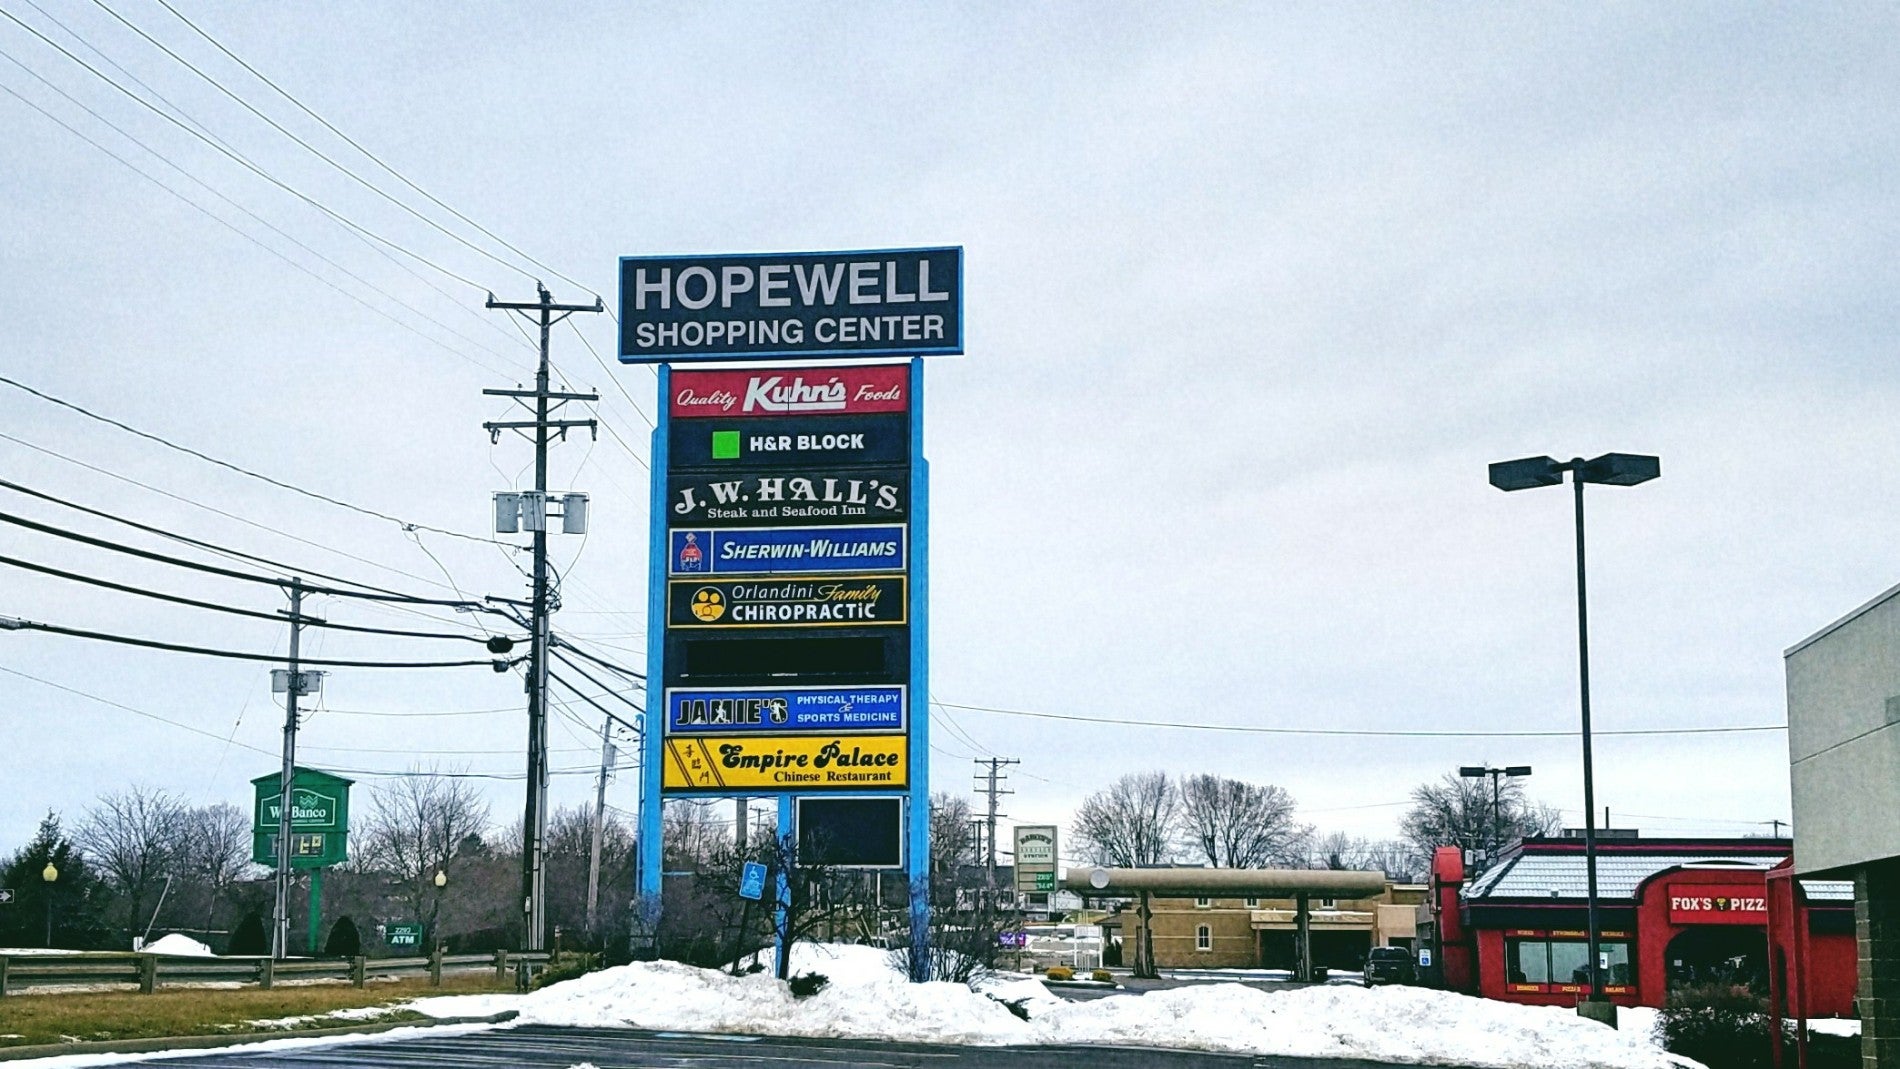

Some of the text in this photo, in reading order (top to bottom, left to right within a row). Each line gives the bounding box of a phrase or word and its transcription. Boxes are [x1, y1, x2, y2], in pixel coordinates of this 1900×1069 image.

[635, 259, 949, 310] HOPEWELL
[636, 315, 945, 348] SHOPPING CENTER
[676, 377, 901, 412] Quality Kuhn's Foods
[750, 433, 864, 451] H&R BLOCK
[756, 477, 899, 510] HALL'S
[707, 505, 866, 519] Steak and Seafood Inn
[720, 539, 897, 560] SHERWIN-WILLIAMS
[732, 584, 882, 603] Orlandini Family
[676, 694, 899, 726] JAMIE'S PHYSICAL THERAPY
[797, 713, 897, 723] SPORTS MEDICINE
[719, 740, 899, 774] Empire Palace
[774, 770, 892, 783] Chinese Restaurant
[269, 806, 326, 818] WBanco
[1671, 897, 1768, 911] FOX'S PIZZ
[391, 935, 415, 944] ATM
